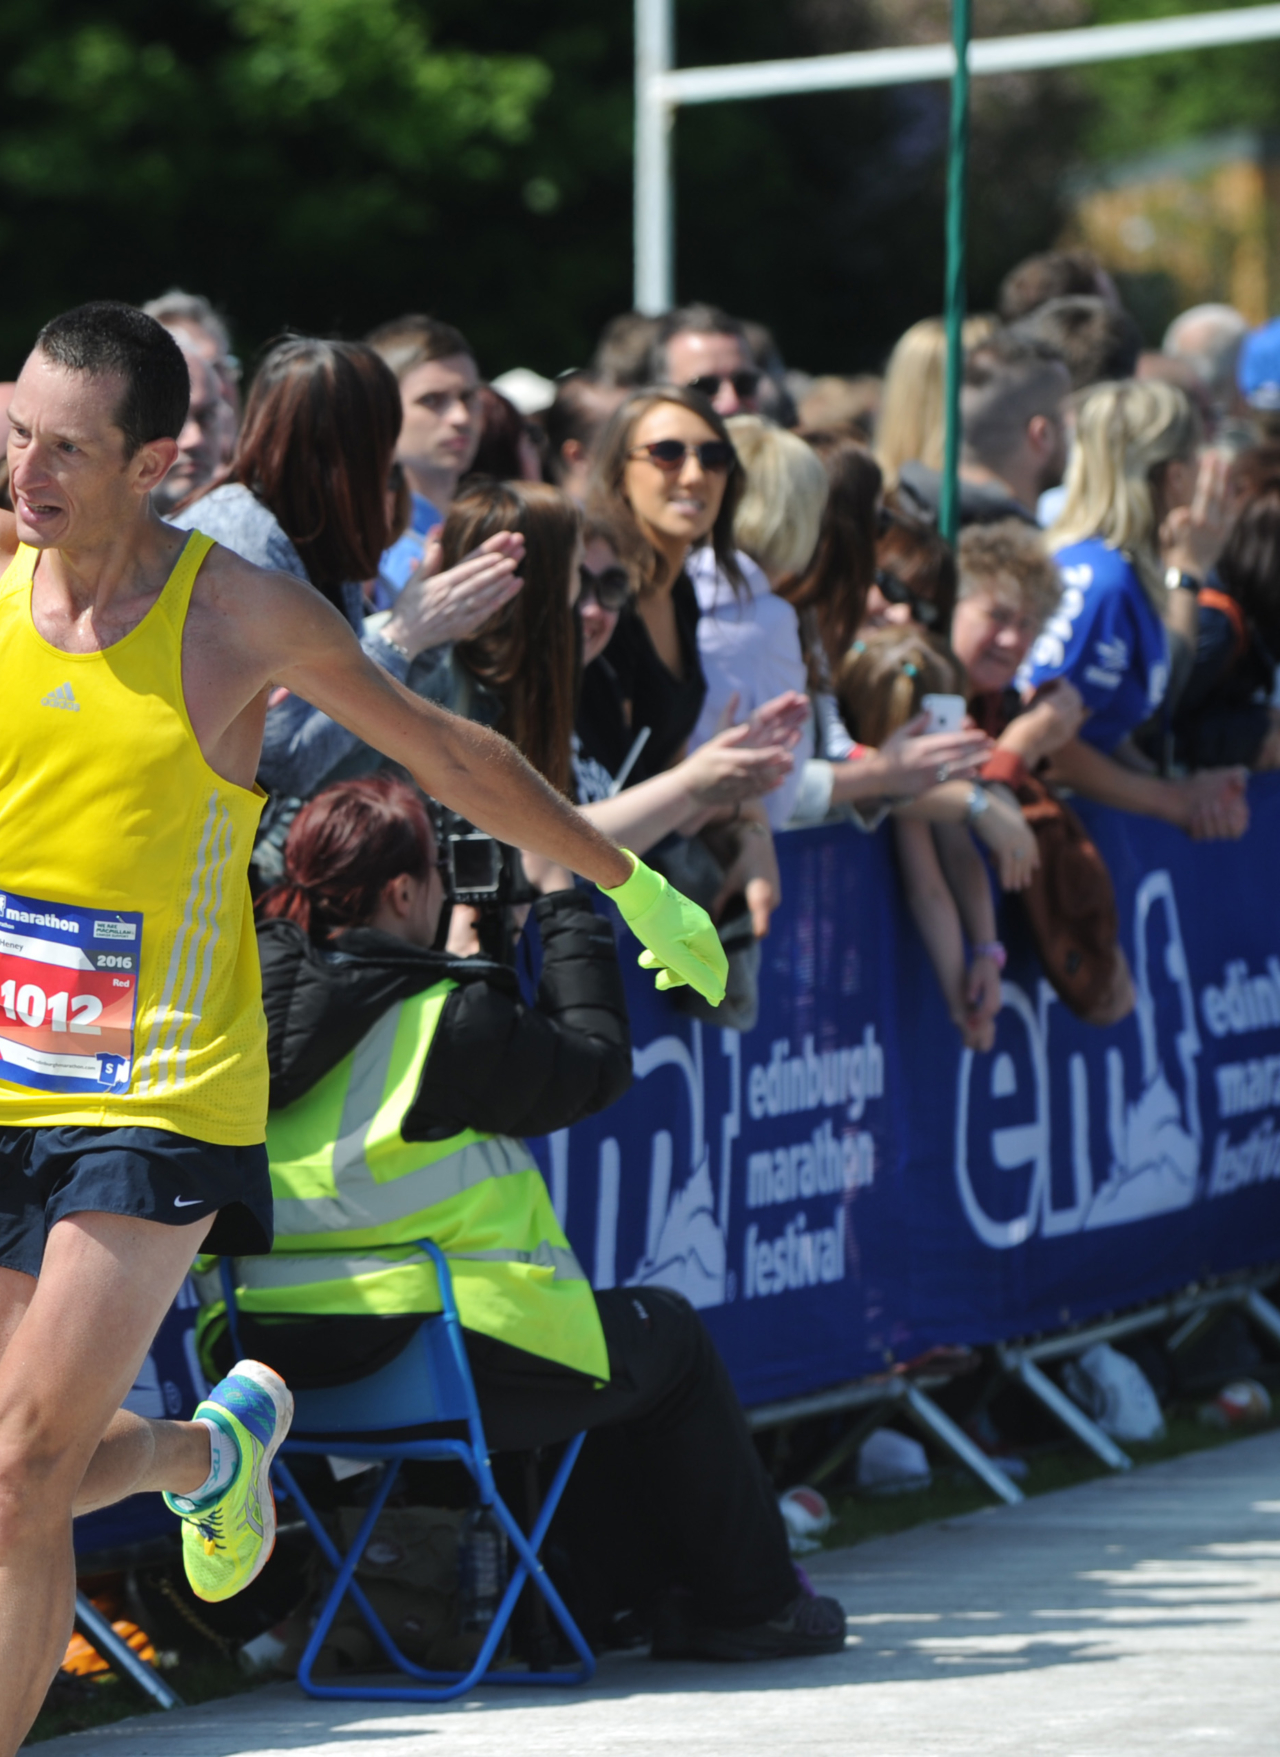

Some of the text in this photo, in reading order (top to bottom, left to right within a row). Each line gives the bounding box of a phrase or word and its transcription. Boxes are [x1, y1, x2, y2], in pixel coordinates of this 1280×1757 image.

[40, 697, 81, 712] adidas
[6, 908, 80, 934] marathon
[96, 954, 133, 970] 2016
[112, 978, 131, 988] Red
[0, 978, 103, 1036] 1012
[105, 1062, 115, 1075] S
[748, 1022, 884, 1121] edinburgh
[746, 1118, 876, 1210] marathon
[743, 1206, 846, 1301] festival
